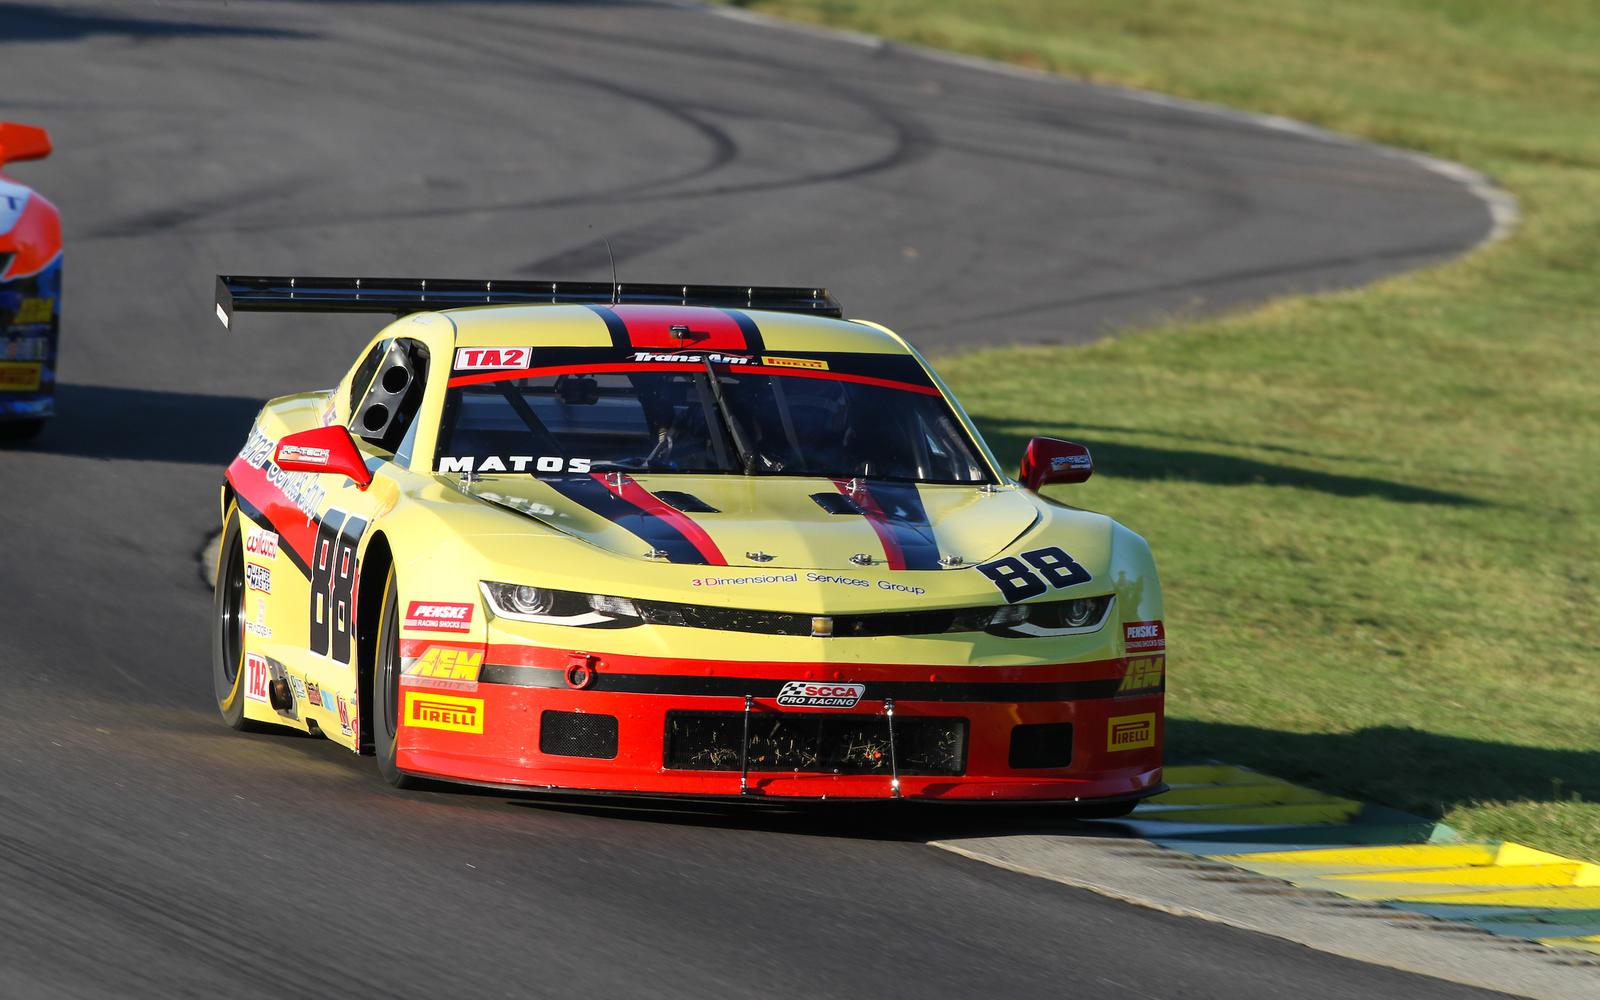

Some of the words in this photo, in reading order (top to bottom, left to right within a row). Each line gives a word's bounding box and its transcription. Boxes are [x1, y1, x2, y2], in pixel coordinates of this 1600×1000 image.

[464, 350, 524, 366] TA2
[633, 352, 701, 363] Trans
[438, 455, 591, 475] MATOS
[247, 564, 271, 581] QUARTER
[975, 546, 1092, 604] 88
[250, 576, 271, 591] MASTER
[309, 508, 367, 665] 88
[806, 572, 870, 587] Services
[877, 580, 926, 595] Group
[413, 605, 469, 619] PENSKE
[417, 619, 438, 627] RACING
[439, 621, 460, 629] SHOCKS
[1127, 625, 1158, 639] PENSKE
[408, 648, 483, 681] AEM
[248, 658, 267, 698] TA2
[1119, 658, 1164, 692] AEM
[805, 686, 858, 697] SCCA
[808, 697, 855, 706] RACING
[413, 699, 477, 726] PIRELLI
[1112, 720, 1150, 745] PIRELLI
